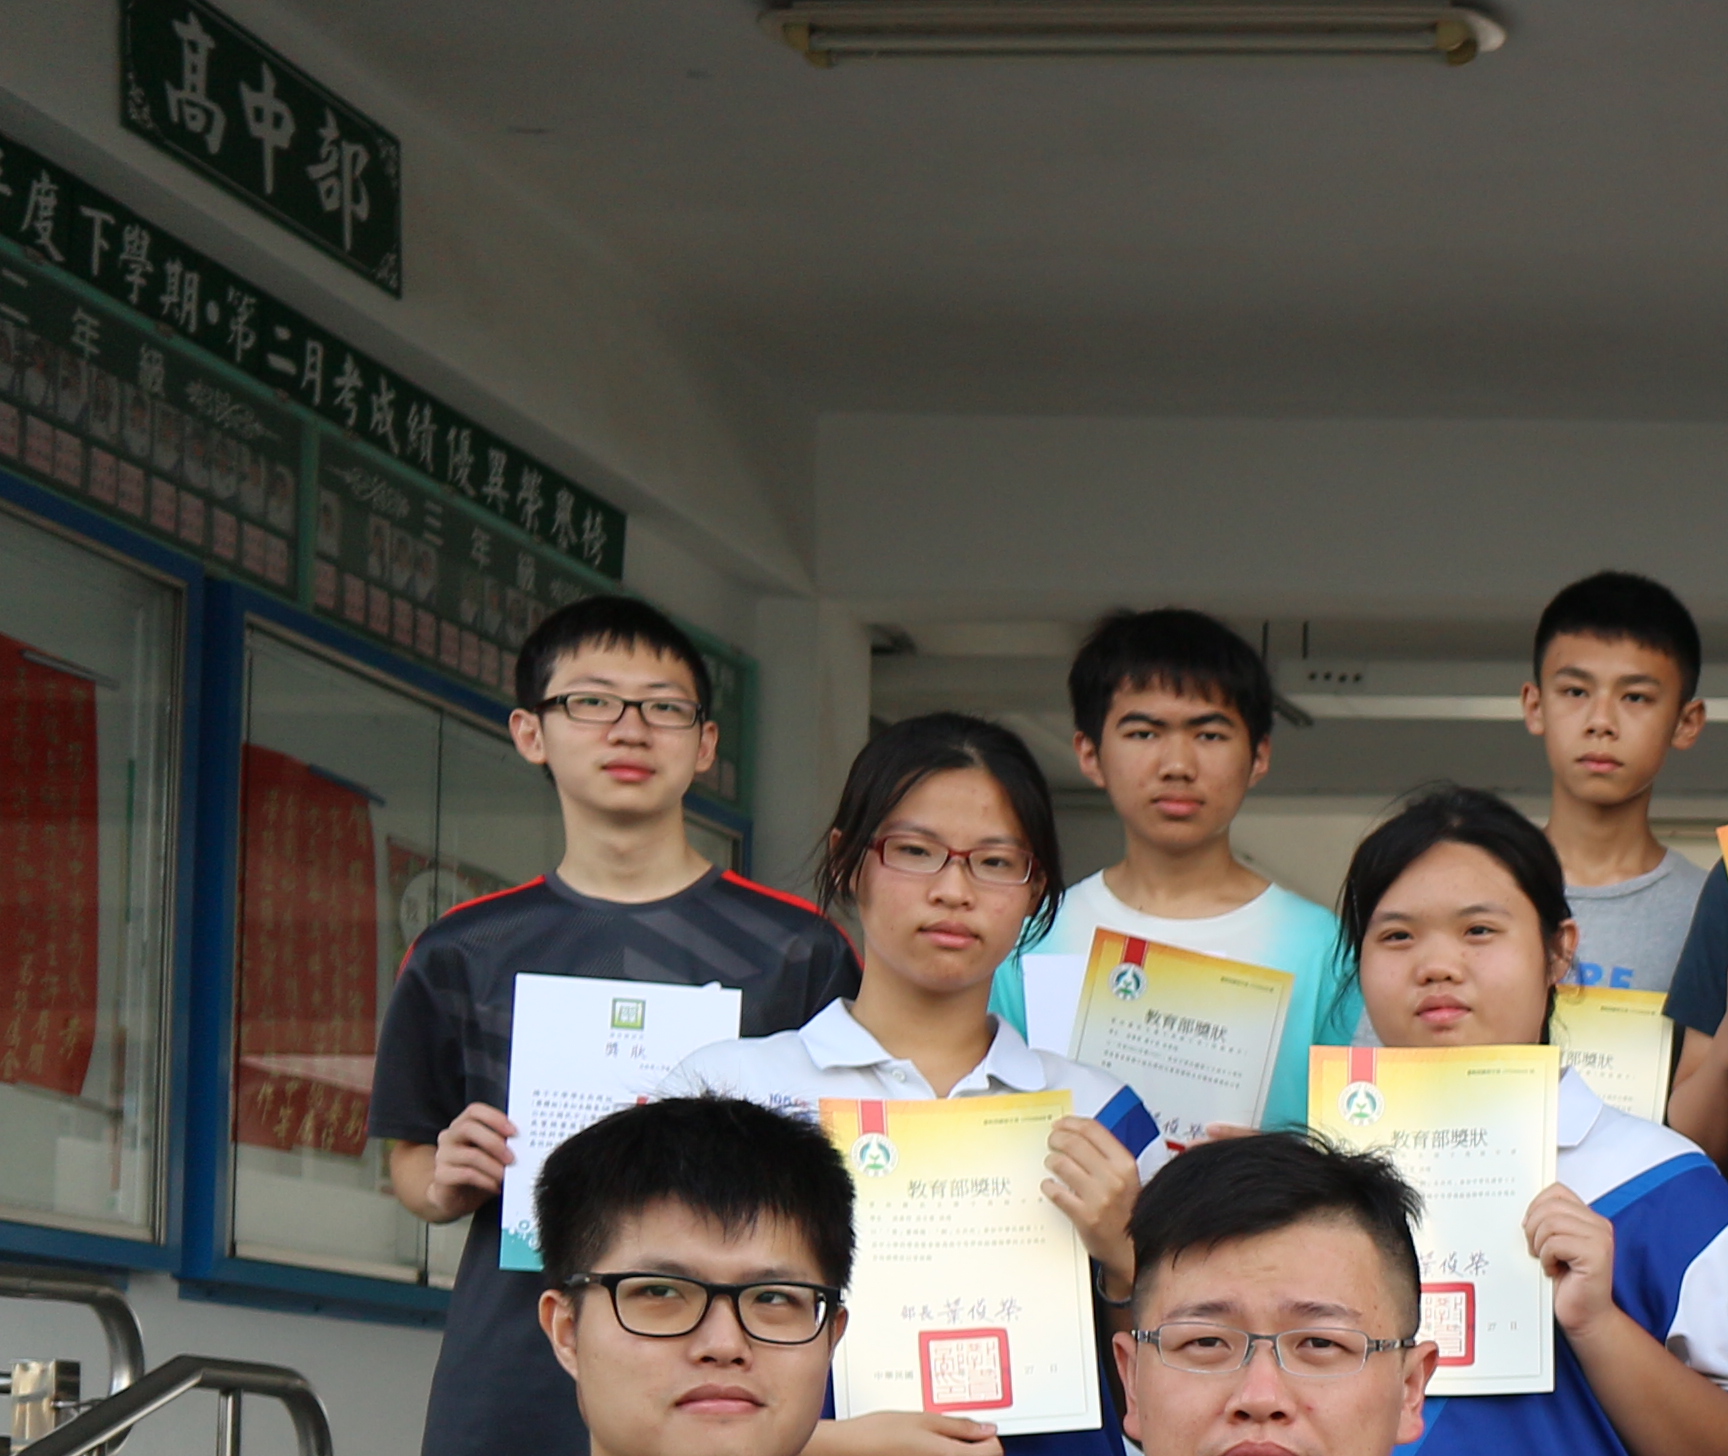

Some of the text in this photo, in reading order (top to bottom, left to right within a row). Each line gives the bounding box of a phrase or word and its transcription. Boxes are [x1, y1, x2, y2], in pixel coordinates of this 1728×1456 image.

[164, 10, 370, 252] 高中部
[1392, 1128, 1489, 1150] 教育部獎狀
[907, 1176, 1012, 1200] 教育部獎狀
